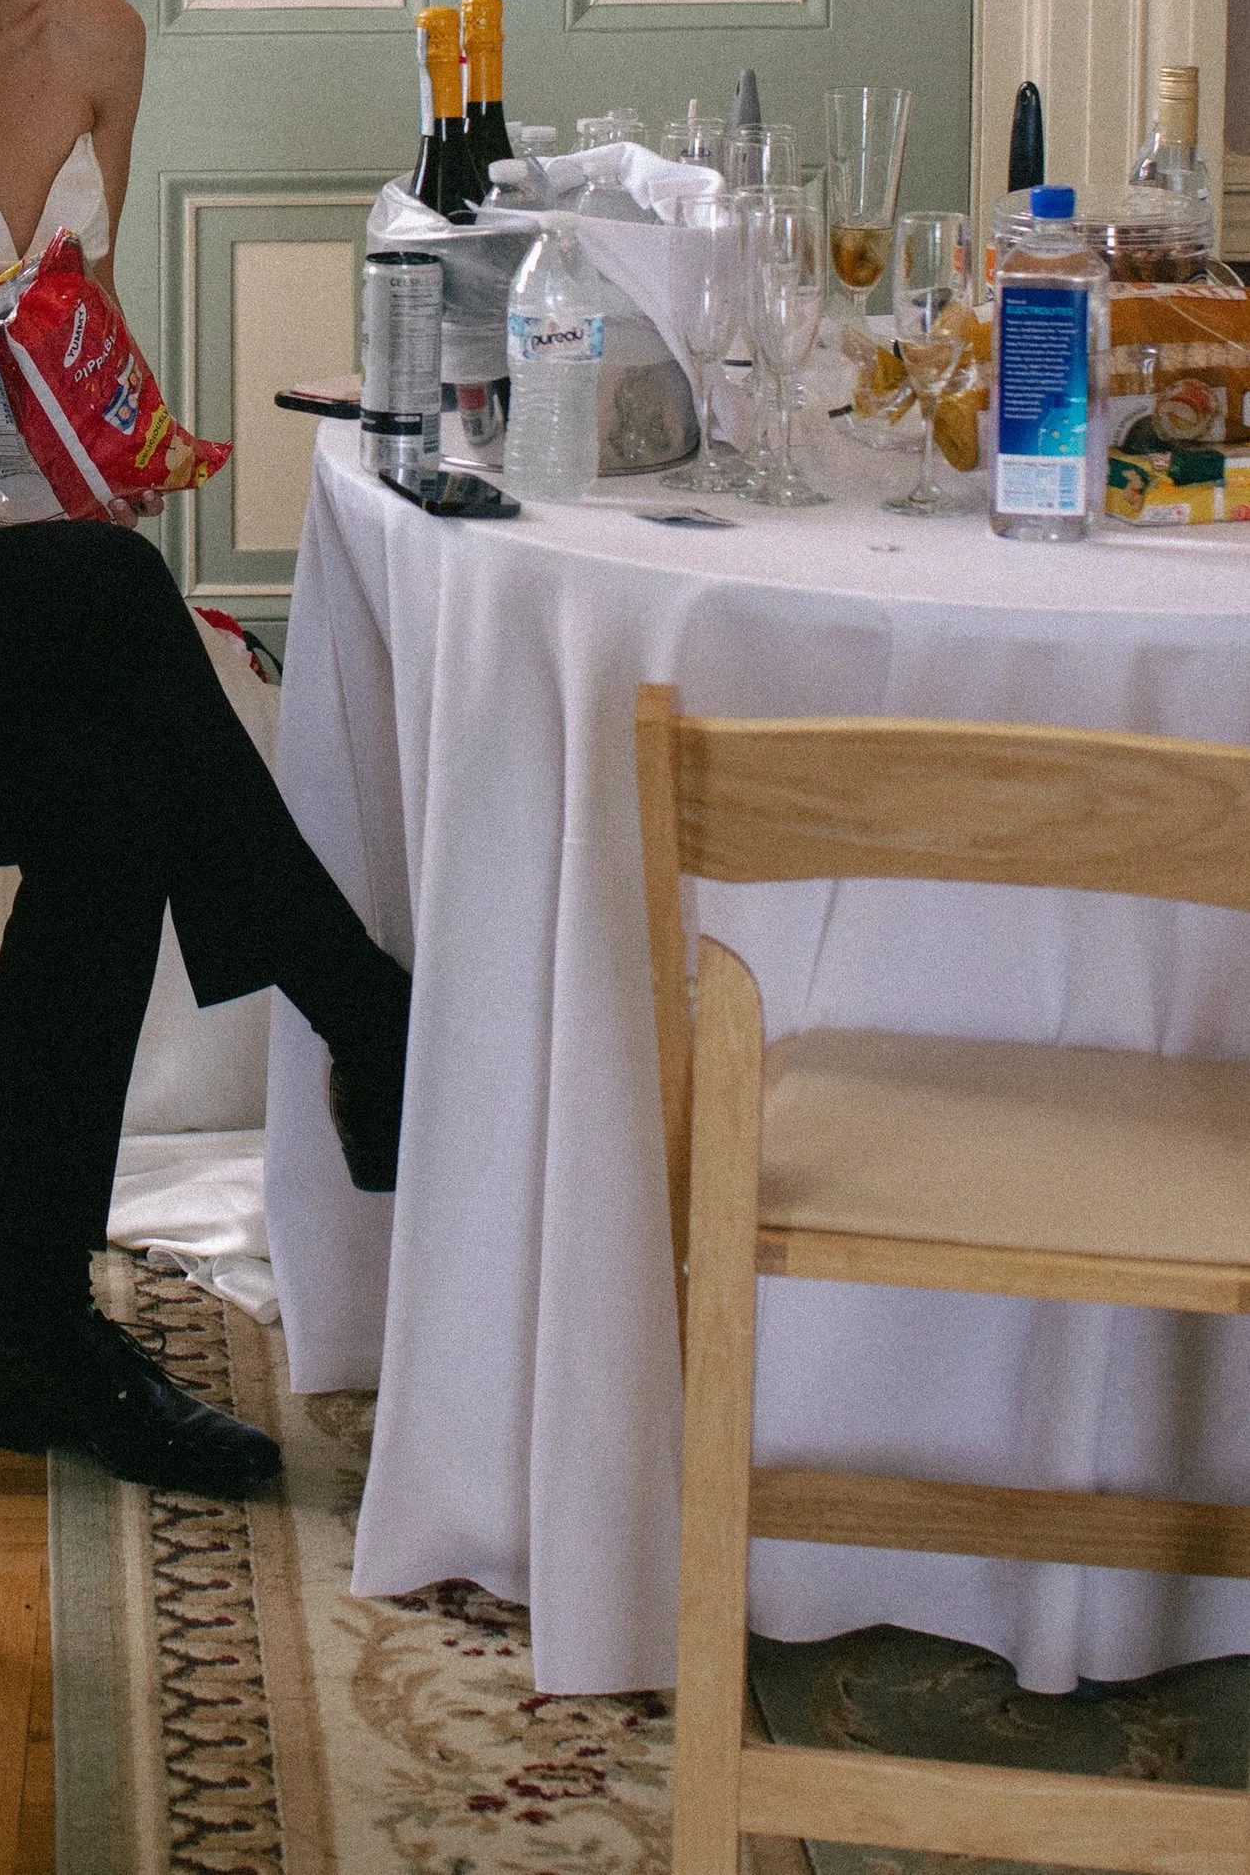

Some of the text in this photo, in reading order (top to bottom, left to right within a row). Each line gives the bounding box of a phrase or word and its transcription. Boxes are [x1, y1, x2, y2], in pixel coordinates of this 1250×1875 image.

[390, 277, 430, 287] CELS
[67, 311, 84, 357] YUMMY
[74, 334, 115, 383] DIPPABL
[139, 408, 168, 466] DELICIOUSLY
